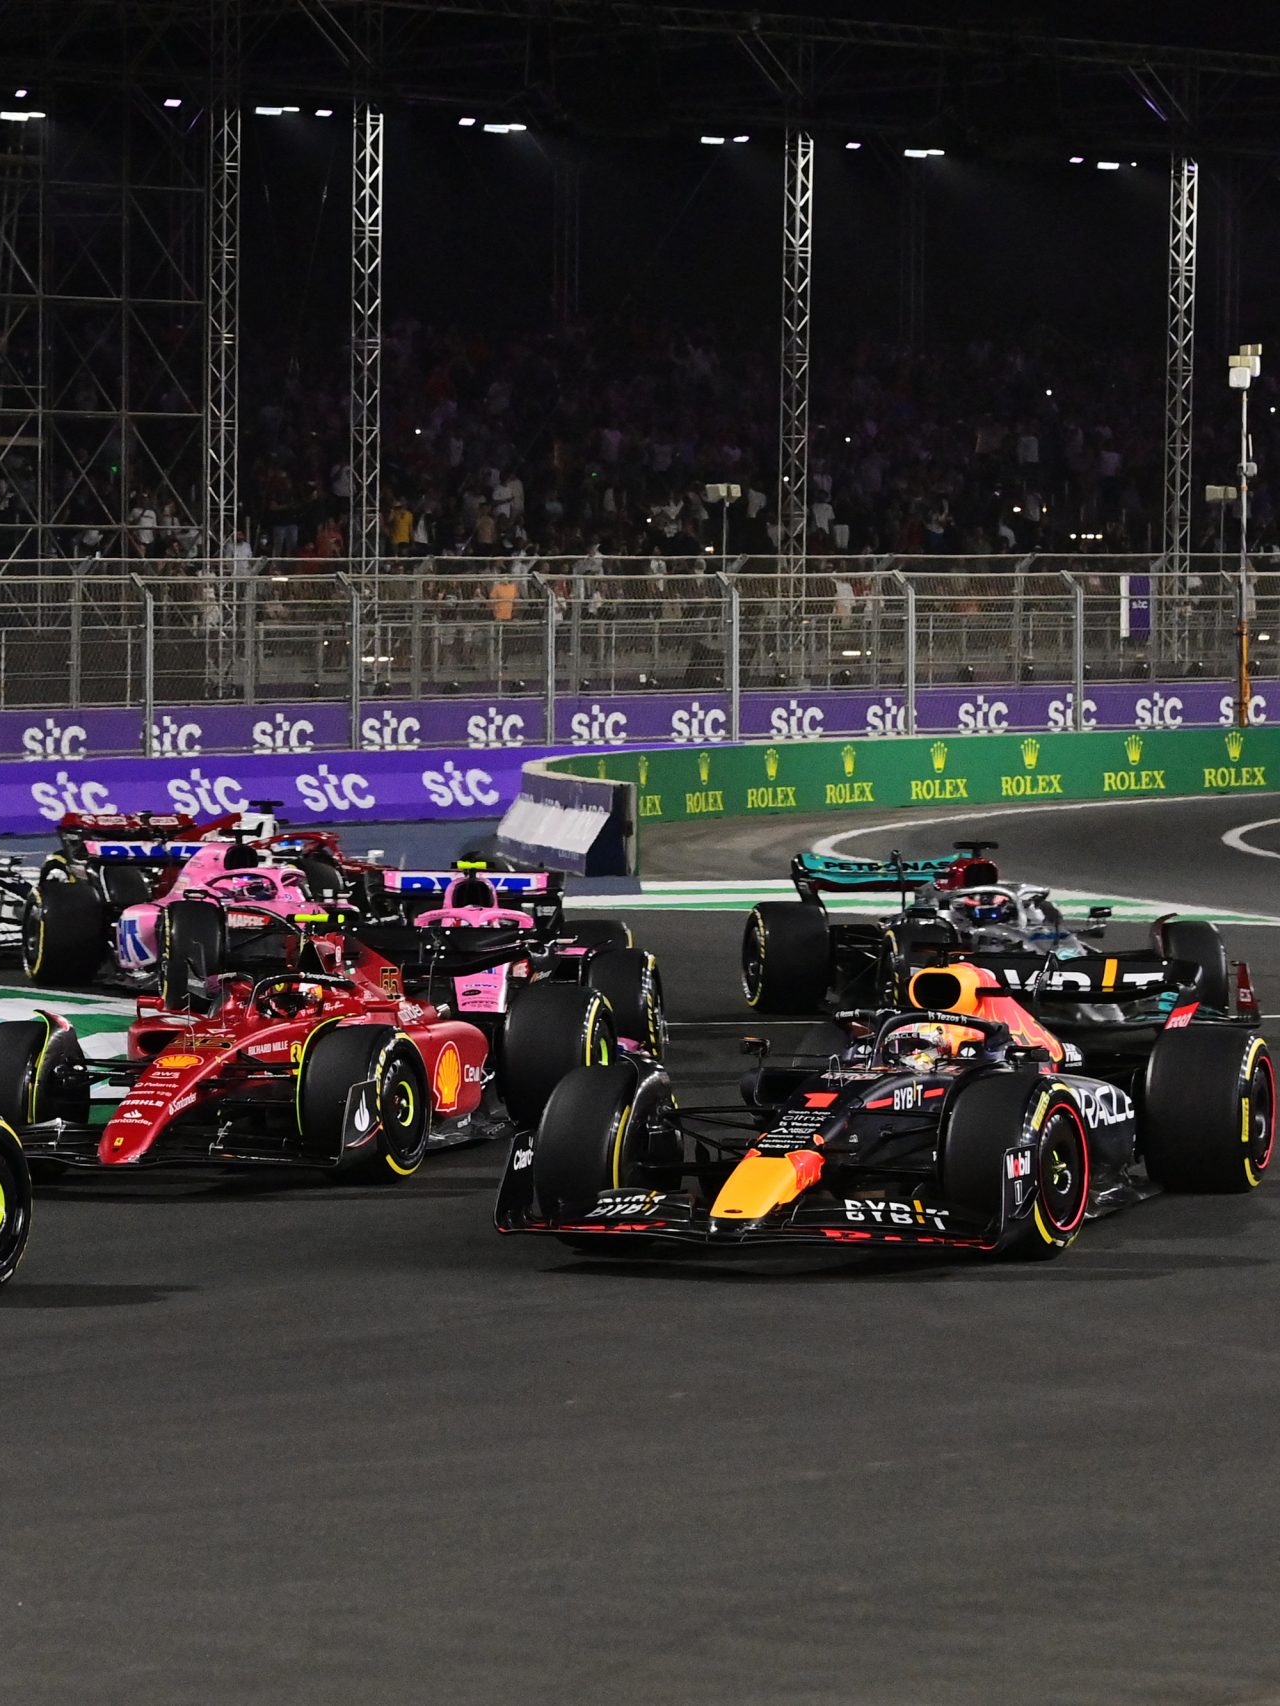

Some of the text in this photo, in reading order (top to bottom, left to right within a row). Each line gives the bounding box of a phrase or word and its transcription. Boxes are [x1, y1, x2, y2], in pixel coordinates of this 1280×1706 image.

[571, 704, 627, 745] stc
[671, 702, 726, 743] stc
[770, 700, 824, 739] stc
[958, 695, 1009, 734] stc
[1135, 692, 1183, 730] stc
[1219, 694, 1266, 727] sc
[22, 718, 87, 761] stc
[252, 712, 314, 753] stc
[361, 710, 420, 750] stc
[467, 707, 524, 749] stc
[167, 768, 250, 816] stc
[295, 764, 375, 811] stc
[422, 761, 499, 807] stc
[826, 782, 874, 804] ROLEX
[910, 779, 968, 800] ROLEX
[1001, 774, 1063, 796] ROLEX
[1103, 770, 1166, 792] ROLEX
[1203, 766, 1267, 788] ROLEX
[31, 771, 118, 821] stc
[639, 795, 662, 817] LEX
[685, 791, 724, 814] ROLEX
[747, 787, 796, 808] ROLEX
[937, 1012, 960, 1023] Tezos
[248, 1041, 288, 1055] RICHARD MILLE
[893, 1080, 923, 1111] BYBIT
[513, 1149, 534, 1171] Claro
[1006, 1151, 1031, 1179] Mobil
[844, 1199, 949, 1231] BYBIT
